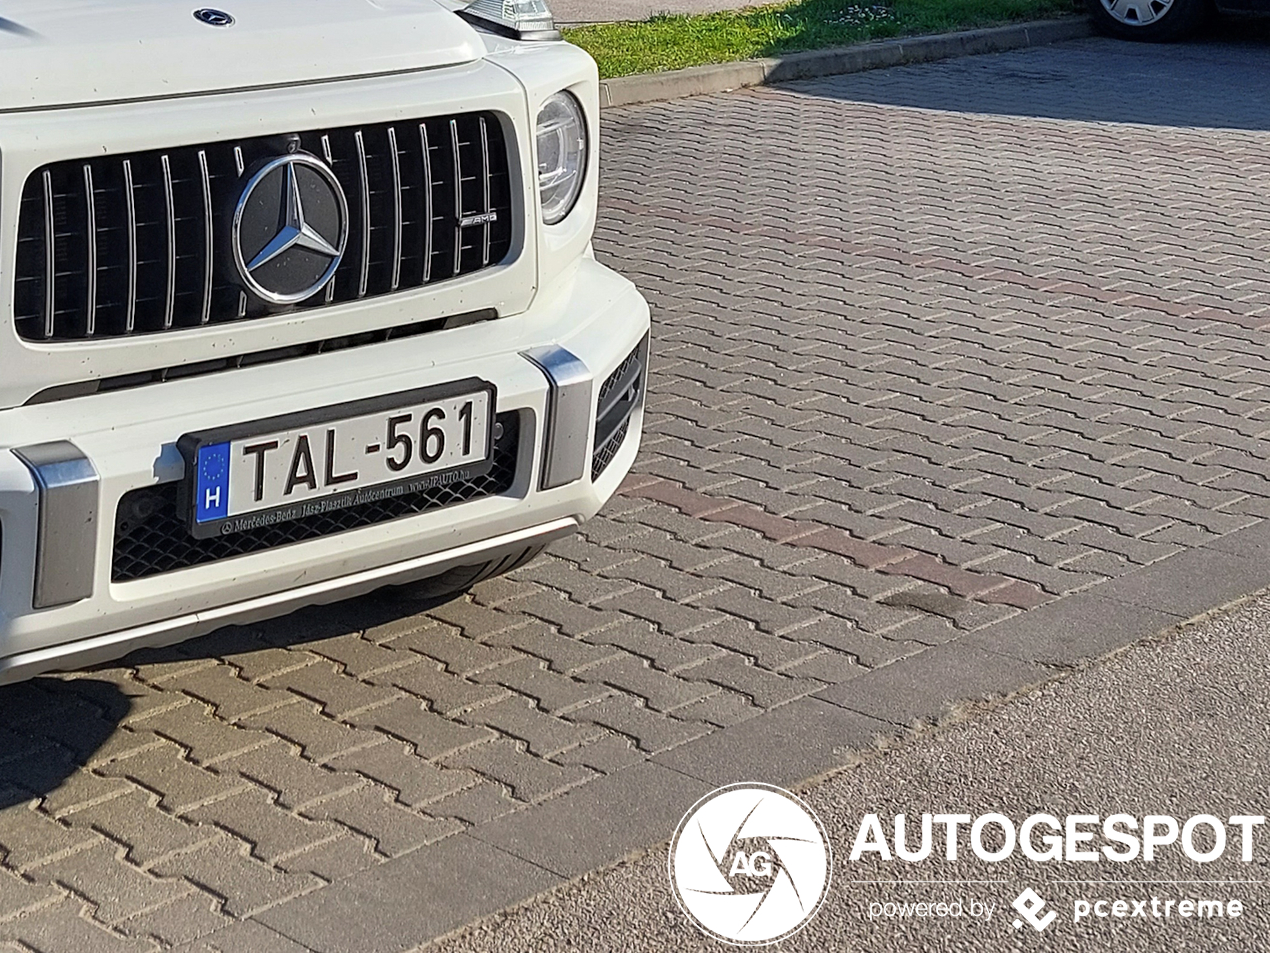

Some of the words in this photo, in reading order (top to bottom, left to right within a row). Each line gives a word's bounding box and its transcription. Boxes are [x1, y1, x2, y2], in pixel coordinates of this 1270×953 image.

[242, 400, 475, 503] TAL-561
[205, 486, 221, 510] H
[233, 509, 297, 533] Mercedes-Benz
